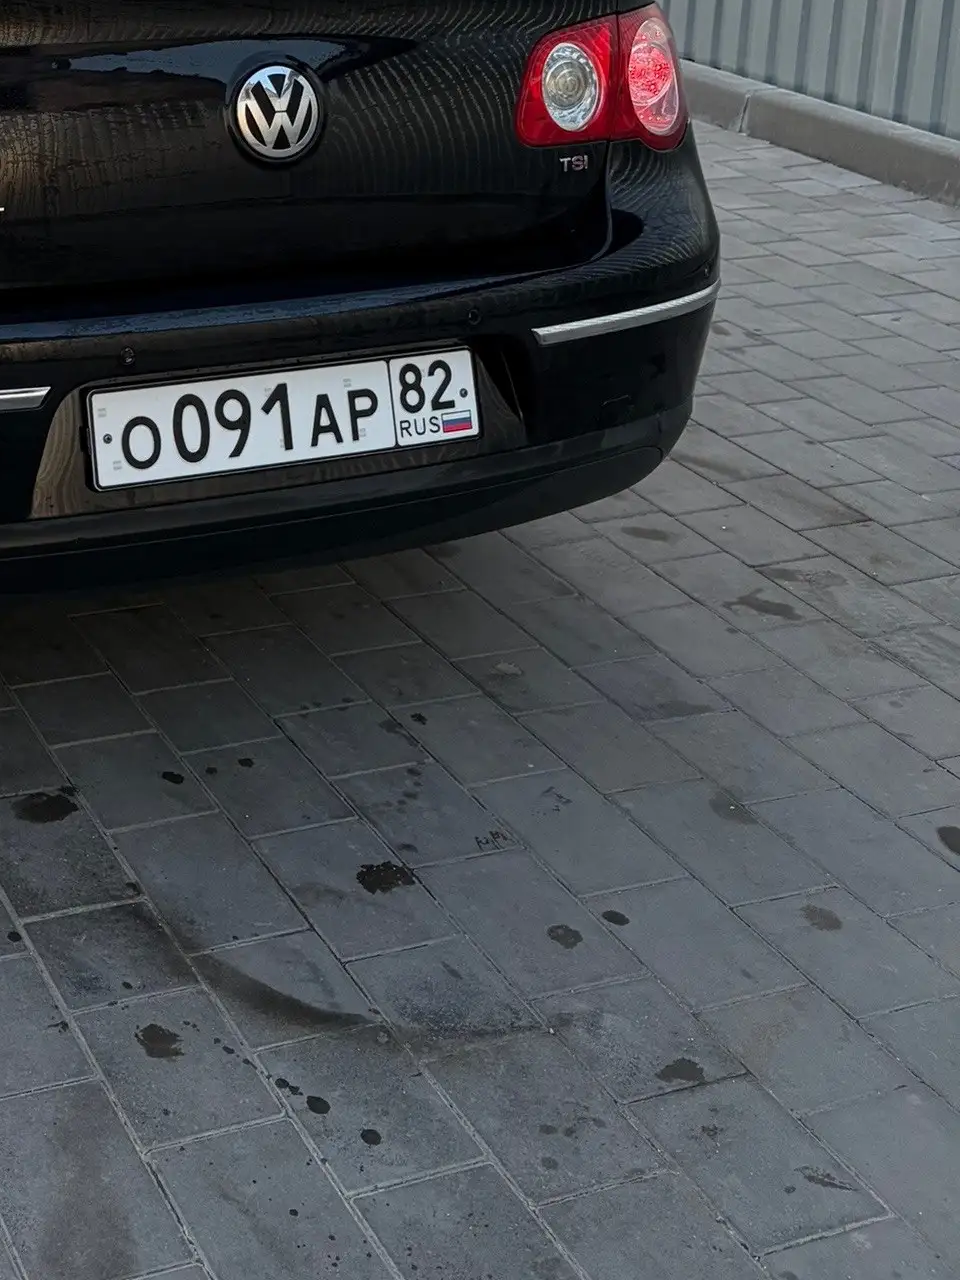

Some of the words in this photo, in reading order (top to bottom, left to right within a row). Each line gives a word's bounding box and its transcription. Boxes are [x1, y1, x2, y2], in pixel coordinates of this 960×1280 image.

[559, 155, 589, 172] TSI
[398, 359, 456, 414] 82
[399, 415, 441, 438] RUS
